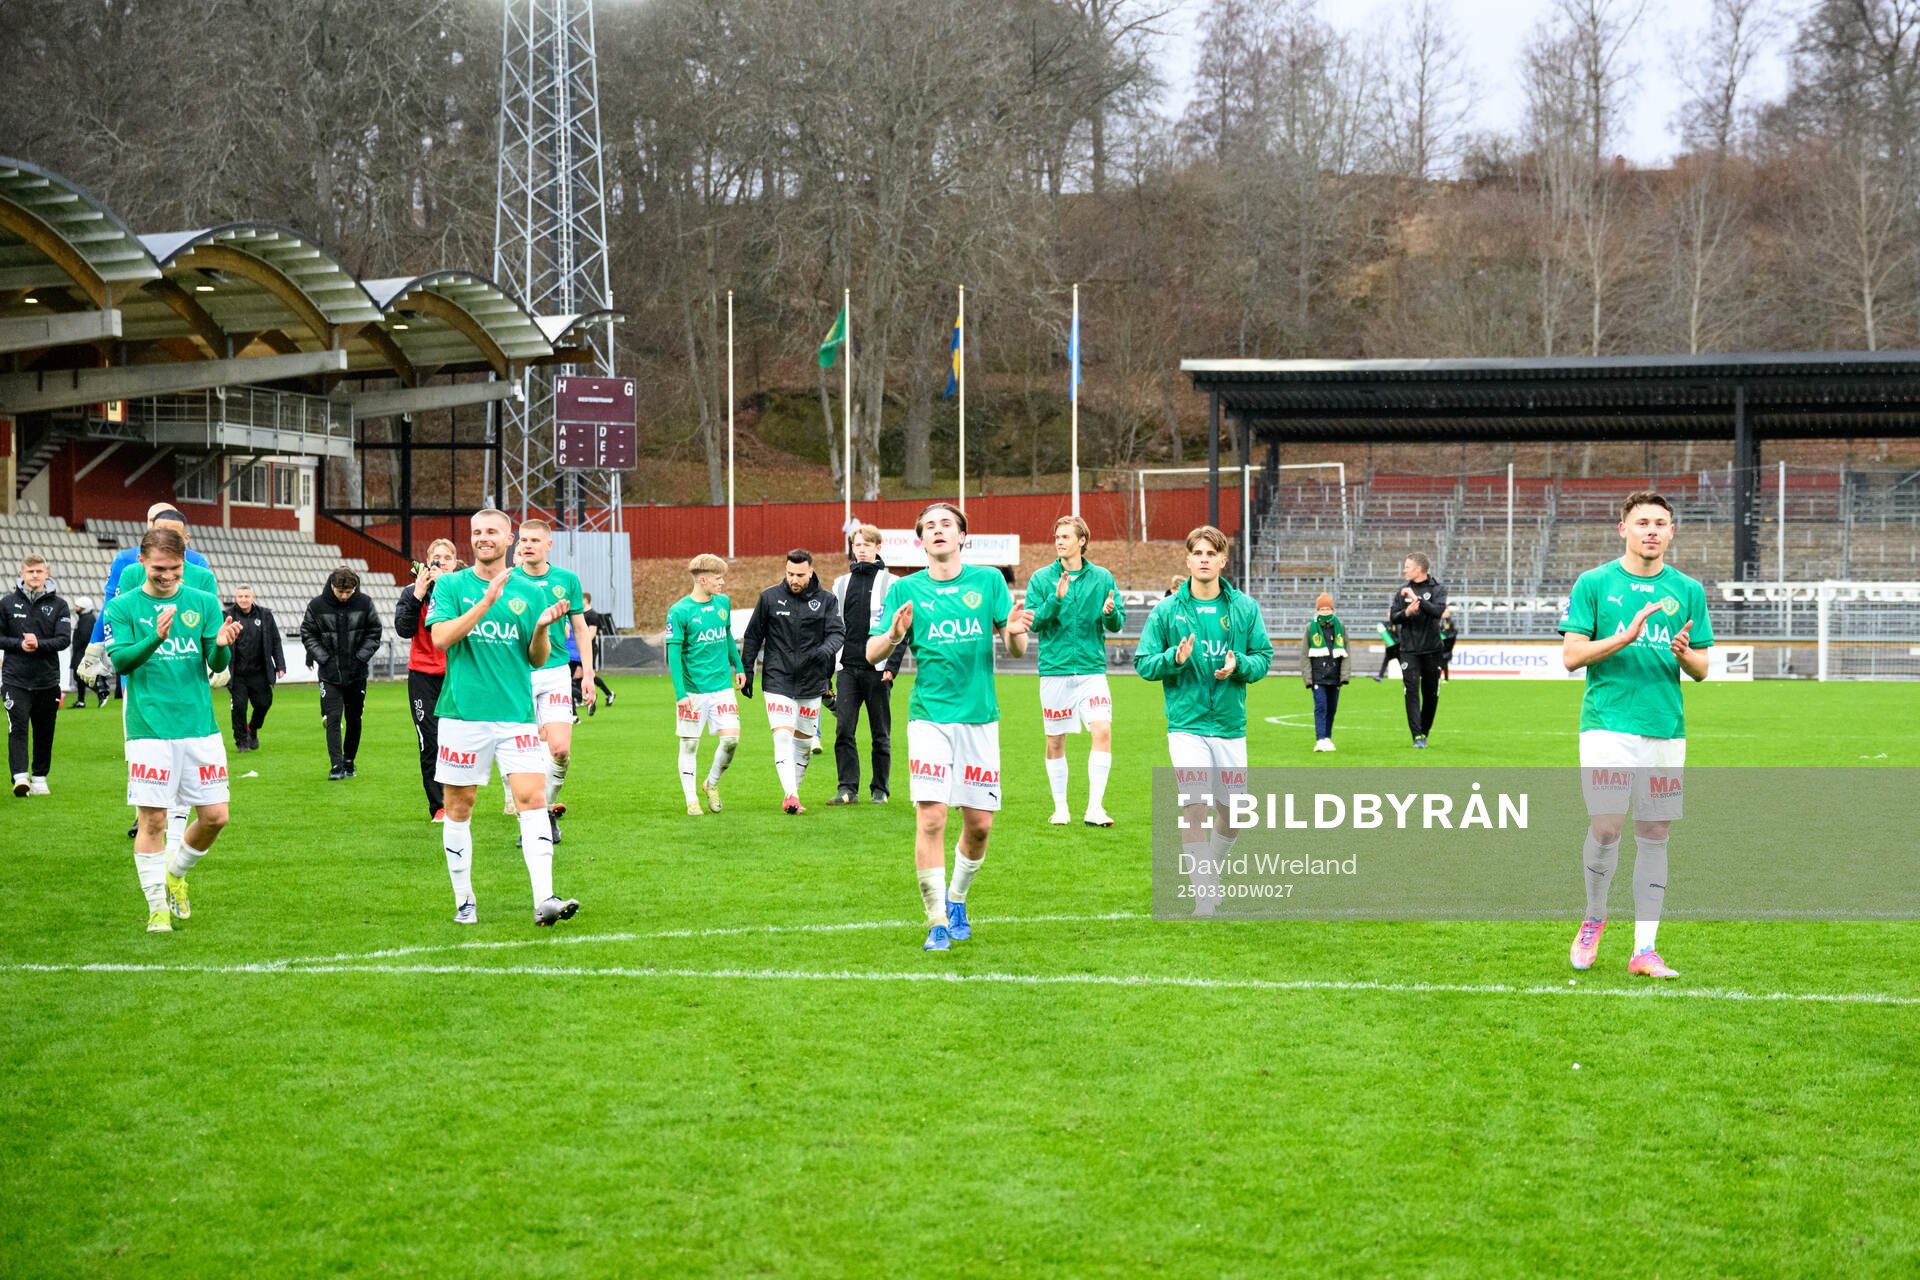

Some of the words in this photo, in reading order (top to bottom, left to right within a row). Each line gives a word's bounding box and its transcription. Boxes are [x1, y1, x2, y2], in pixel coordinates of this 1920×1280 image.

[557, 379, 567, 393] H
[624, 382, 634, 396] G
[559, 425, 567, 436] A
[599, 426, 607, 437] D
[559, 439, 567, 450] B
[599, 441, 607, 451] E
[559, 453, 567, 465] C
[599, 455, 607, 465] F
[882, 536, 909, 546] erox
[467, 620, 519, 640] AQUA
[696, 626, 727, 642] AQUA
[927, 617, 983, 640] AQUA
[1200, 639, 1228, 657] QUA
[1449, 650, 1549, 667] dbäckens
[414, 699, 423, 709] 30
[767, 702, 792, 715] MAXI
[1043, 708, 1073, 719] MAXI
[439, 745, 477, 765] MAXI
[131, 763, 171, 782] MAXI
[910, 759, 945, 779] MAXI
[964, 765, 999, 783] MAX
[1176, 768, 1207, 783] MAXI
[1592, 769, 1631, 786] MAXI
